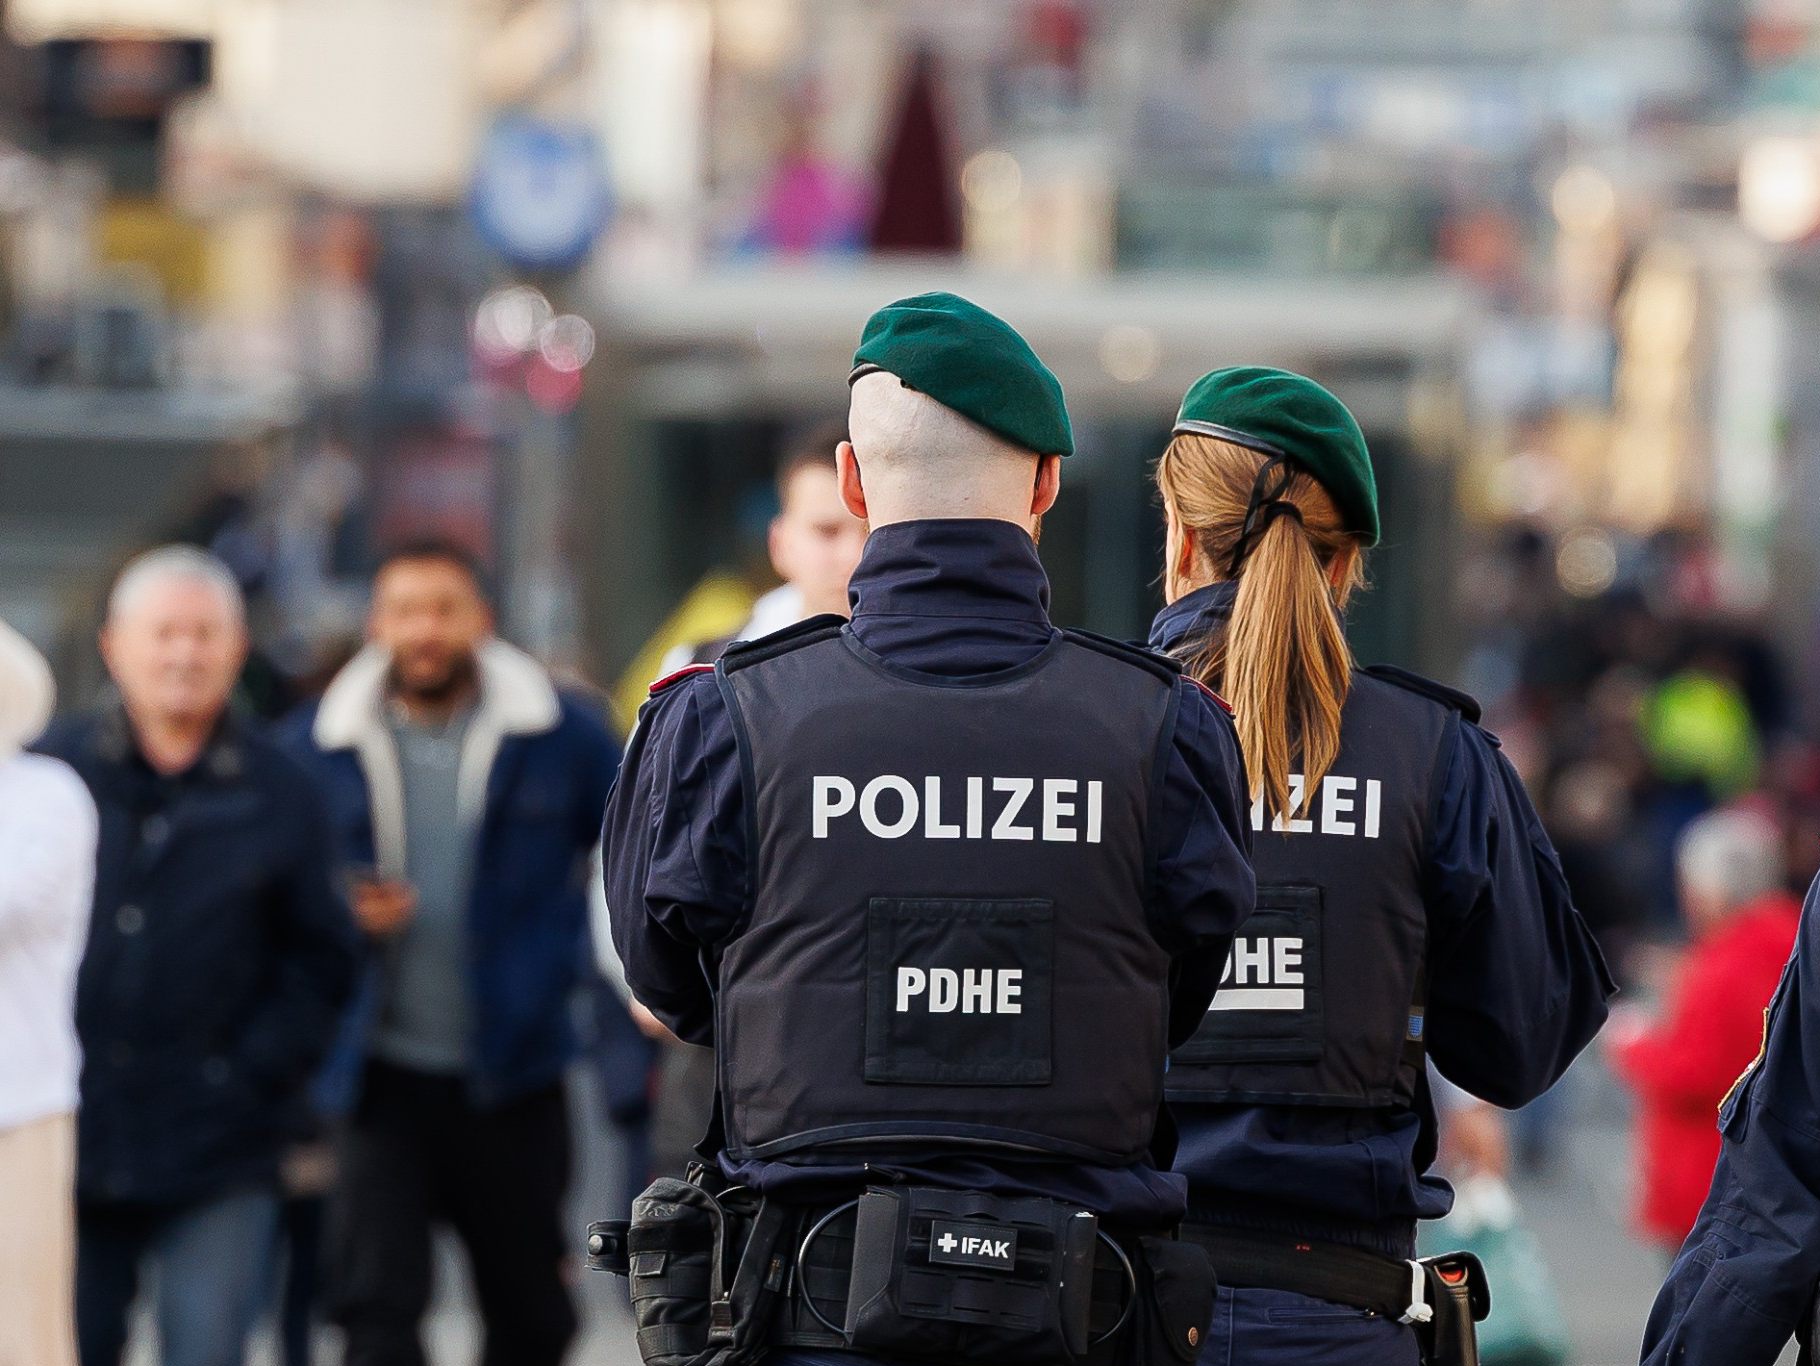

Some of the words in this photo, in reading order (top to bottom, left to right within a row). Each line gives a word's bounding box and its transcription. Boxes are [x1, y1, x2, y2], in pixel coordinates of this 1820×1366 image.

[812, 774, 1103, 843] POLIZEI
[1219, 937, 1304, 984] HE
[896, 966, 1022, 1014] PDHE
[961, 1236, 1010, 1259] IFAK
